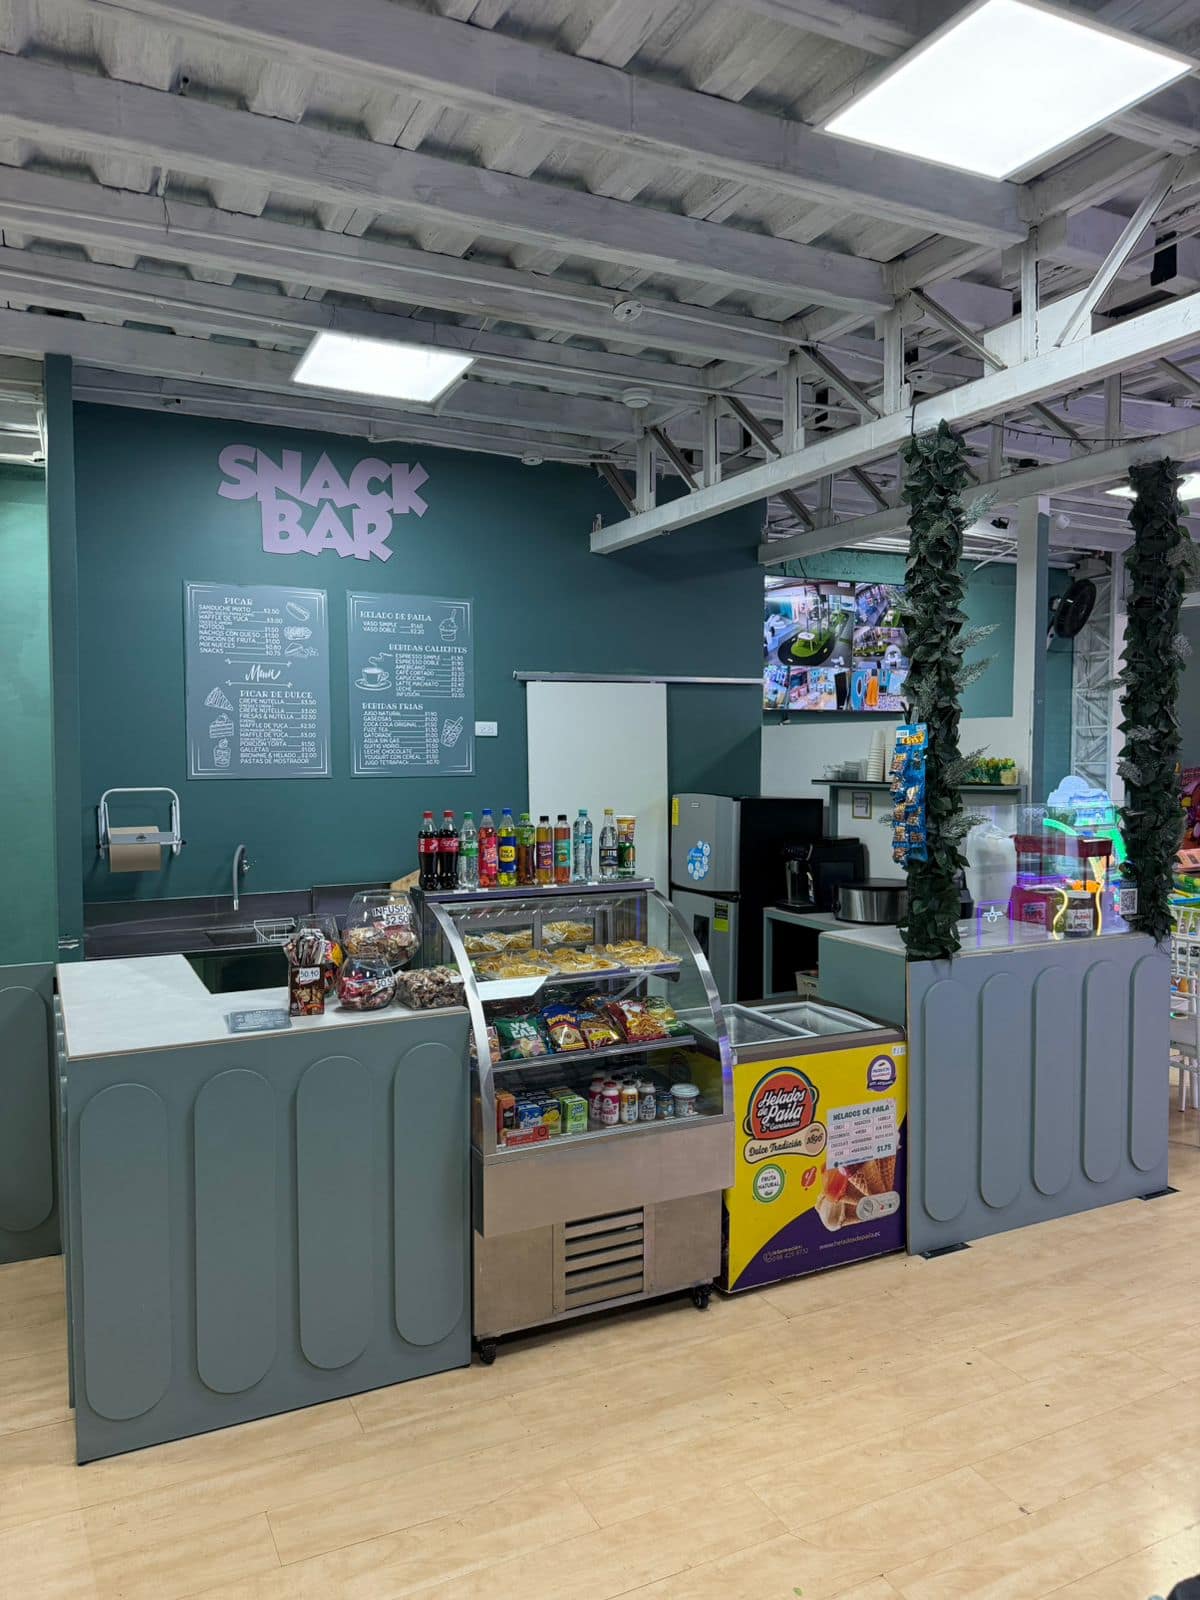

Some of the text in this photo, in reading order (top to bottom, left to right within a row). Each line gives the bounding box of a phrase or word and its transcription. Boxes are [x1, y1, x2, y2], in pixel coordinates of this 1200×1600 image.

[217, 443, 430, 518] SNACK
[261, 499, 395, 563] BAR
[224, 597, 253, 606] PICAR
[360, 611, 394, 620] HELADO
[396, 612, 407, 620] DE
[389, 644, 423, 652] BEBIDAS
[240, 690, 313, 699] PICAR DE DULCE
[362, 702, 398, 710] BEBIDAS
[758, 1087, 806, 1108] Helados
[757, 1102, 804, 1124] de Paila
[832, 1110, 861, 1121] HELADOS
[872, 1104, 890, 1114] PAILA
[748, 1144, 768, 1157] Dulce
[876, 1144, 892, 1153] $1.75
